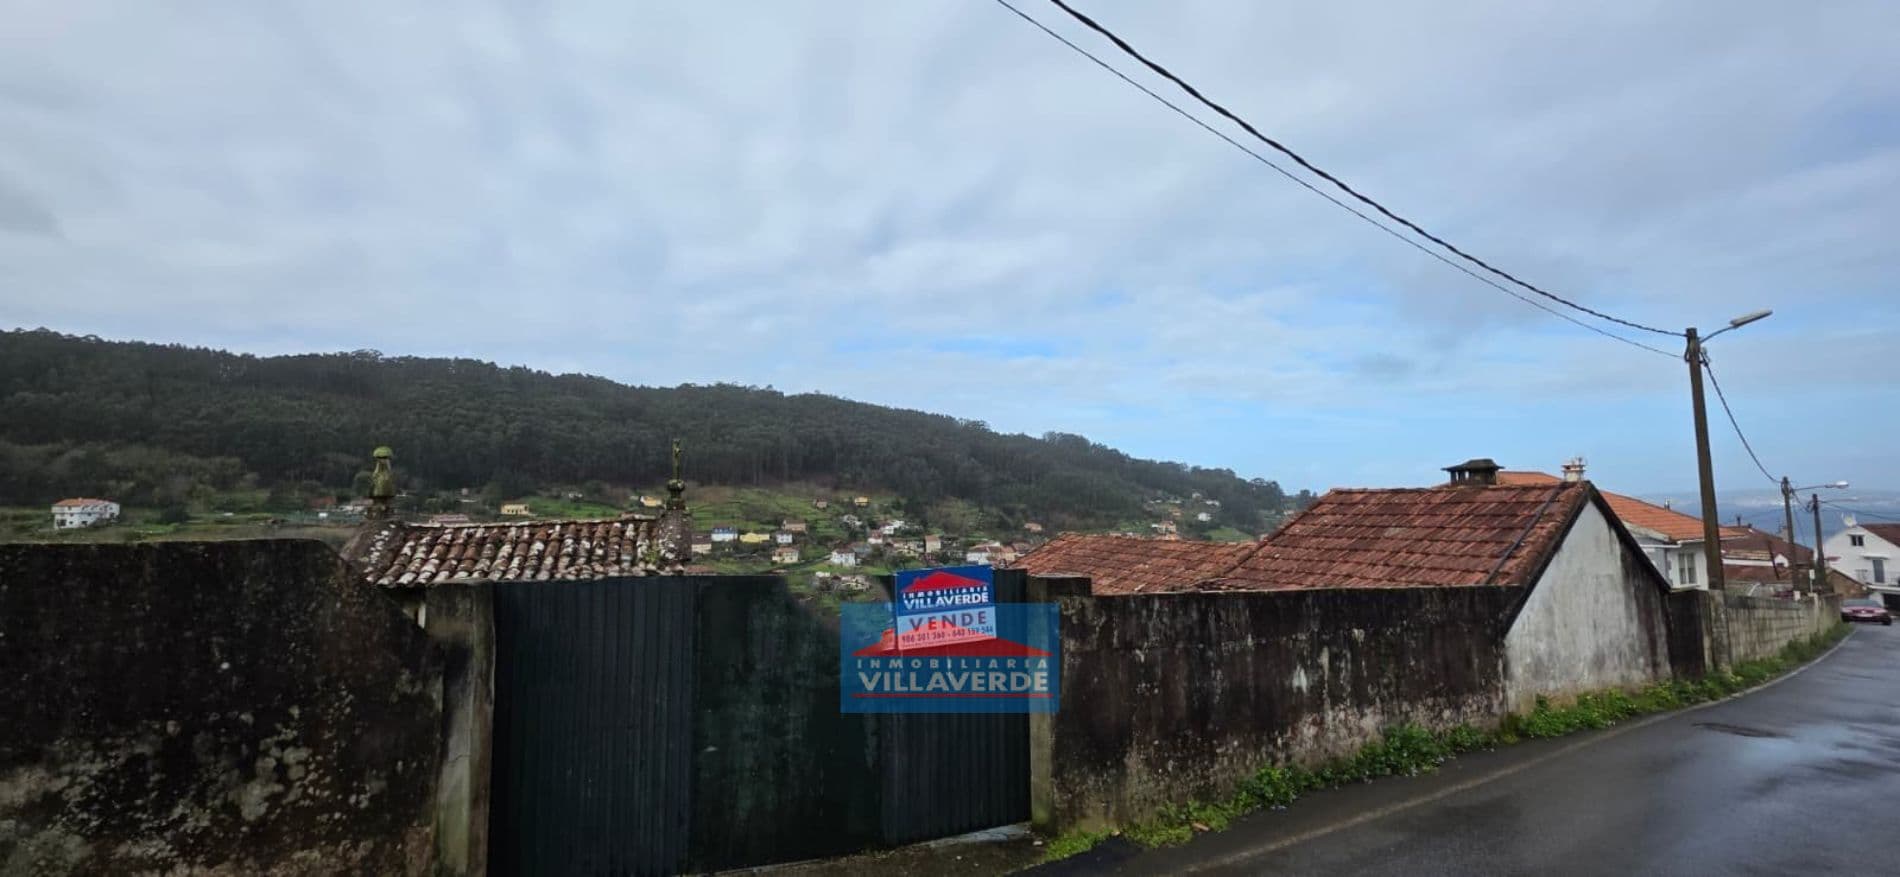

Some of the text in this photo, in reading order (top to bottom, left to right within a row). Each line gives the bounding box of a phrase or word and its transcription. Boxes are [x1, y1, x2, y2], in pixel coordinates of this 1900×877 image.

[903, 585, 988, 599] INMOBILIARIA
[904, 591, 989, 610] VILLAVERDE
[909, 610, 987, 631] VENDE
